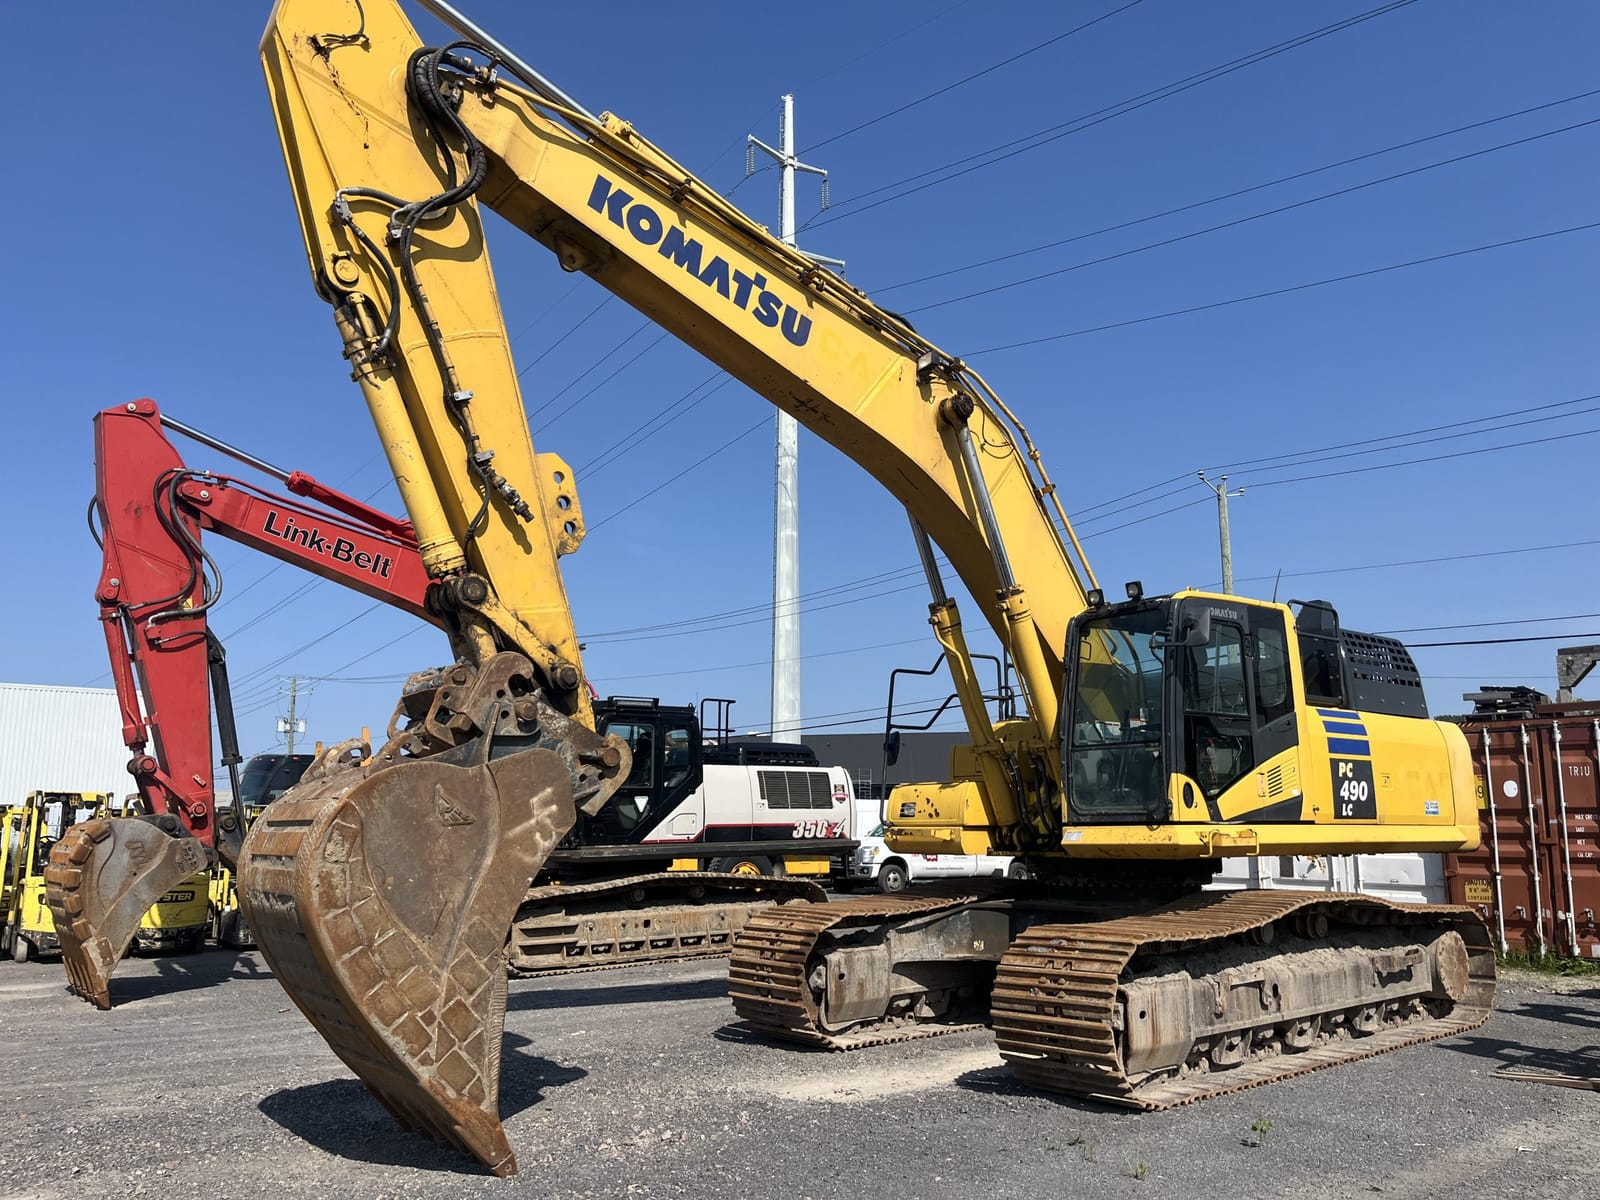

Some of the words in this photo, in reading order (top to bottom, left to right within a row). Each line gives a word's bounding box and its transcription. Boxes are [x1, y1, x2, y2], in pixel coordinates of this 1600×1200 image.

[587, 174, 812, 347] KOMATSU
[263, 510, 393, 579] Link-Belt
[1338, 762, 1353, 777] PC
[1340, 780, 1368, 801] 490
[1342, 803, 1353, 816] LC
[162, 892, 192, 901] STER
